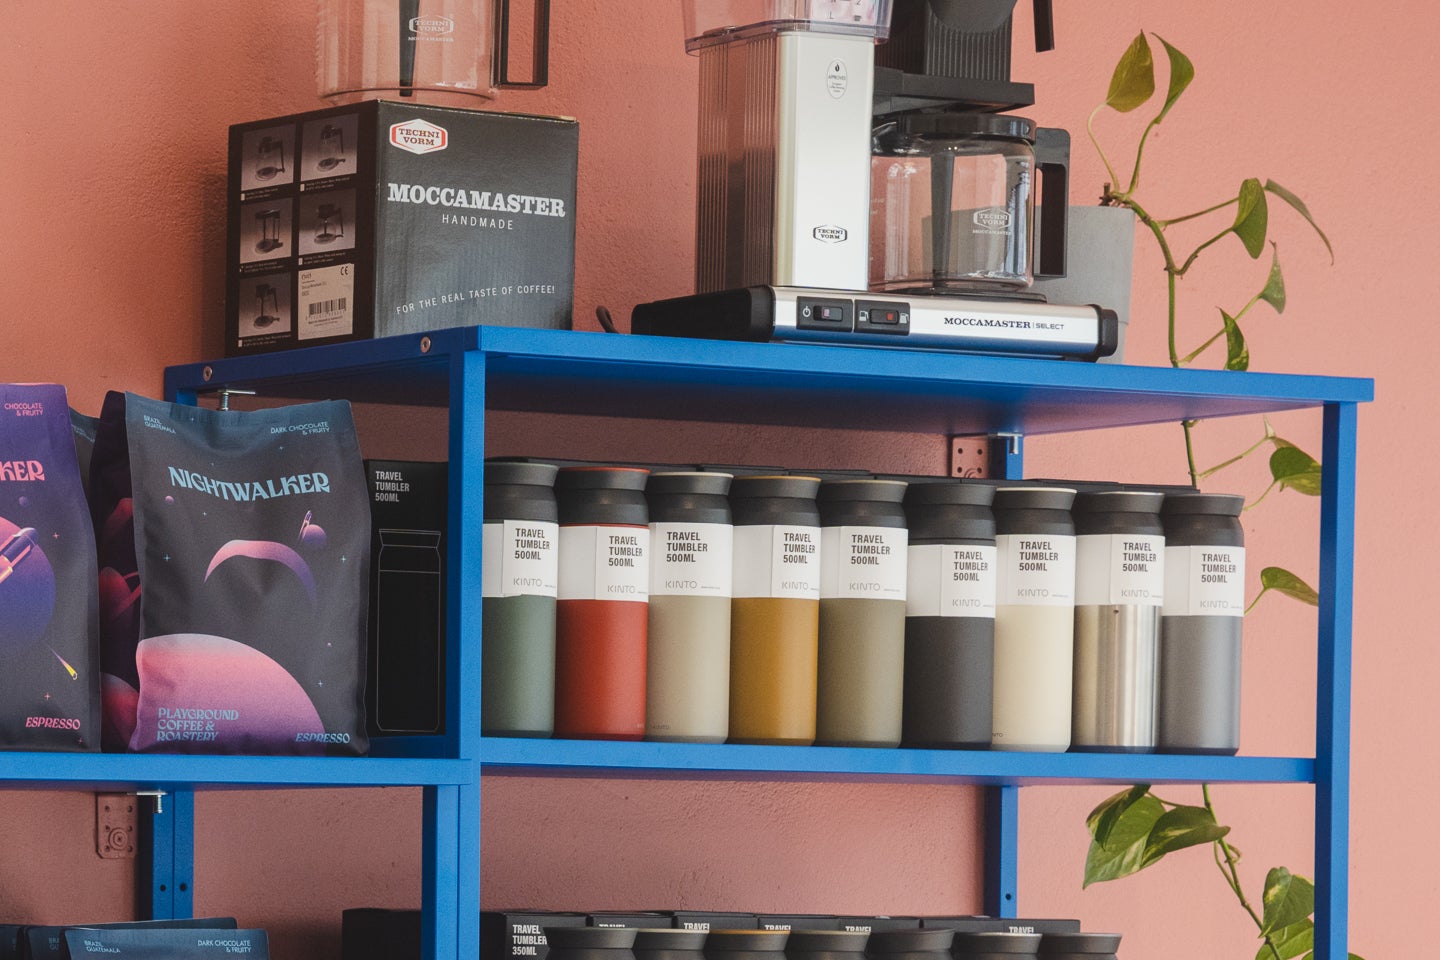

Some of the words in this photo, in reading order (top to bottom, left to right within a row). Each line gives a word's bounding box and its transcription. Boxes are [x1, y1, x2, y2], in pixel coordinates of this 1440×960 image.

[398, 128, 440, 139] TECHNI
[403, 136, 434, 146] VORM
[388, 183, 565, 218] MOCCAMASTER
[442, 214, 514, 230] HANDMADE
[396, 302, 415, 314] FOR
[419, 296, 437, 309] THE
[442, 292, 465, 304] REAL
[469, 287, 496, 298] TASTE
[502, 286, 513, 294] OF
[518, 285, 555, 294] COFFEE!
[944, 318, 1030, 328] MOCCAMASTER
[4, 402, 43, 410] CHOCOLATE
[289, 421, 328, 432] CHOCOLATE
[376, 471, 403, 481] TRAVEL
[168, 466, 330, 502] NIGHTWALKER
[375, 482, 410, 492] TUMBLER
[375, 493, 399, 503] 500ML
[515, 528, 545, 539] TRAVEL
[667, 532, 700, 541] TRAVEL
[784, 533, 811, 542] TRAVEL
[609, 536, 637, 545] TRAVEL
[852, 535, 884, 543] TRAVEL
[515, 539, 550, 550] TUMBLER
[667, 542, 708, 552] TUMBLER
[784, 544, 815, 554] TUMBLER
[1020, 541, 1052, 550] TRAVEL
[1123, 542, 1151, 551] TRAVEL
[515, 550, 541, 560] 500ML
[609, 547, 643, 557] TUMBLER
[851, 545, 890, 555] TUMBLER
[666, 553, 696, 563] 500ML
[783, 554, 808, 564] 500ML
[851, 556, 879, 565] 500ML
[954, 551, 983, 560] TRAVEL
[1020, 552, 1058, 561] TUMBLER
[1123, 553, 1156, 562] TUMBLER
[1202, 554, 1231, 562] TRAVEL
[608, 558, 635, 568] 500ML
[954, 562, 988, 571] TUMBLER
[1019, 562, 1048, 571] 500ML
[1123, 563, 1148, 572] 500ML
[1202, 564, 1236, 573] TUMBLER
[953, 572, 980, 581] 500ML
[1201, 574, 1227, 583] 500ML
[665, 580, 697, 589] KINTO
[850, 582, 880, 591] KINTO
[1018, 589, 1049, 597] KINTO
[158, 708, 239, 720] PLAYGROUND
[26, 717, 80, 730] ESPRESSO
[158, 720, 203, 731] COFFEE
[205, 721, 214, 731] &
[157, 731, 219, 741] ROASTERY
[295, 733, 350, 744] ESPRESSO
[512, 924, 541, 934] TRAVEL
[512, 935, 547, 945] TUMBLER
[512, 946, 537, 956] 350ML
